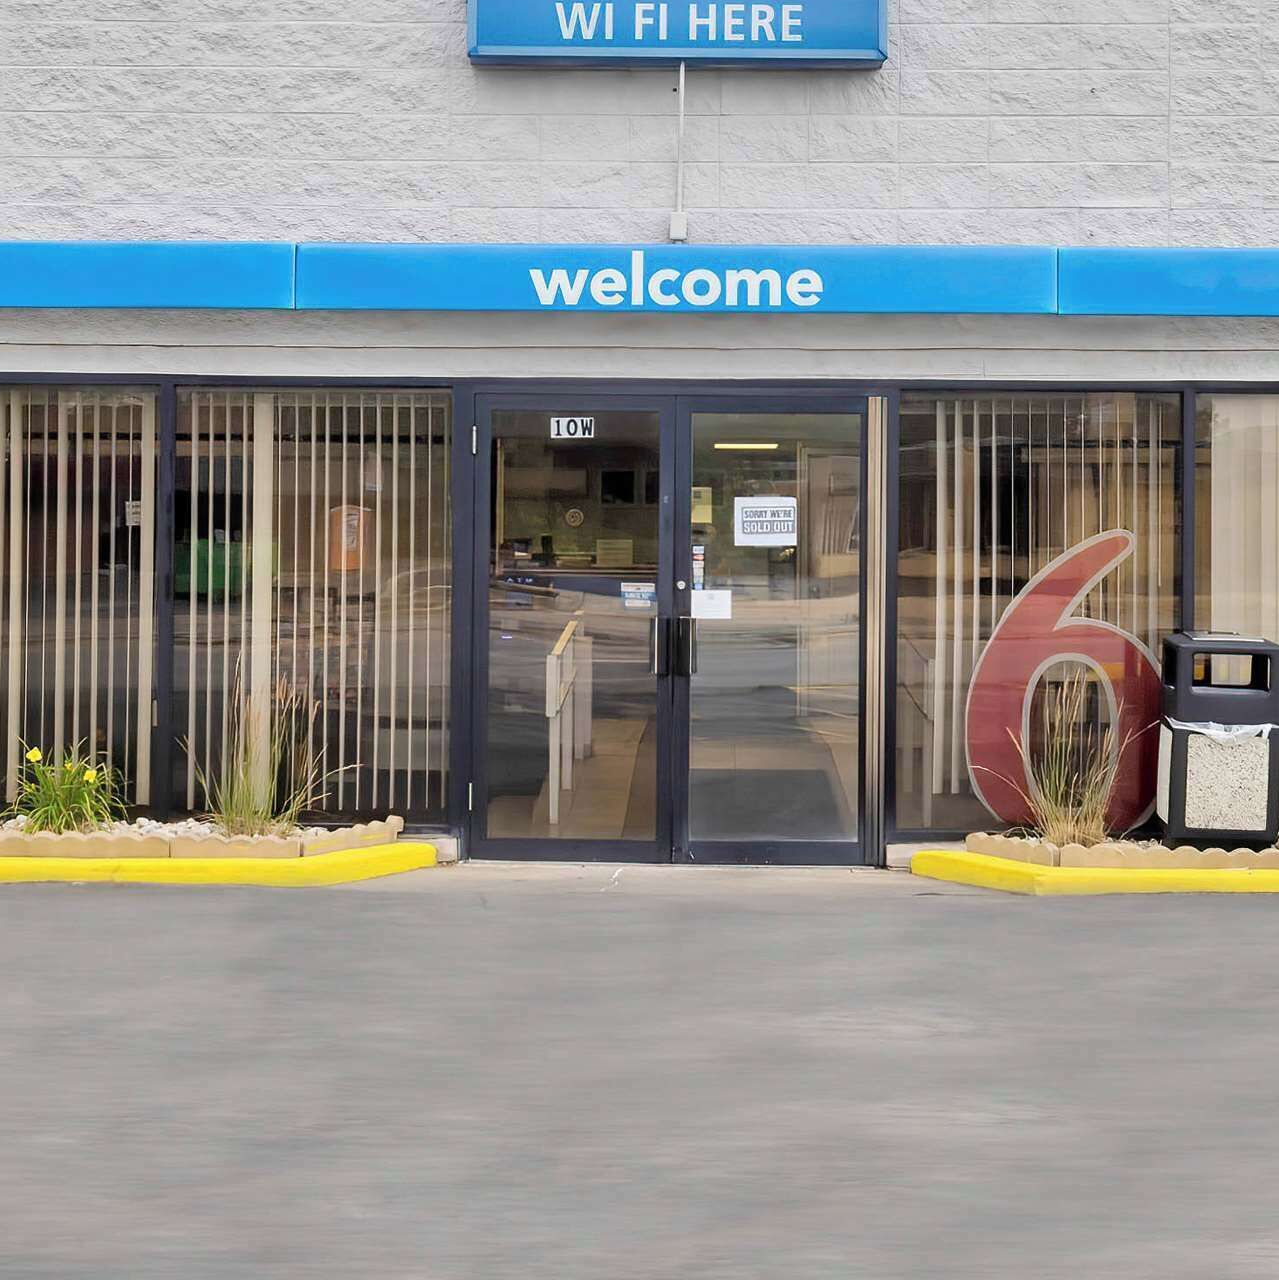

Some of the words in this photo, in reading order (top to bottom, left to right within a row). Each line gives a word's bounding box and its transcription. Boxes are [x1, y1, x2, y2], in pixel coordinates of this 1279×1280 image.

[555, 2, 614, 40] WI
[634, 3, 669, 40] FI
[688, 3, 803, 42] HERE
[528, 250, 824, 306] welcome
[743, 510, 768, 519] SORRY
[743, 521, 771, 533] SOLD
[773, 521, 793, 532] OUT
[964, 528, 1162, 833] 6
